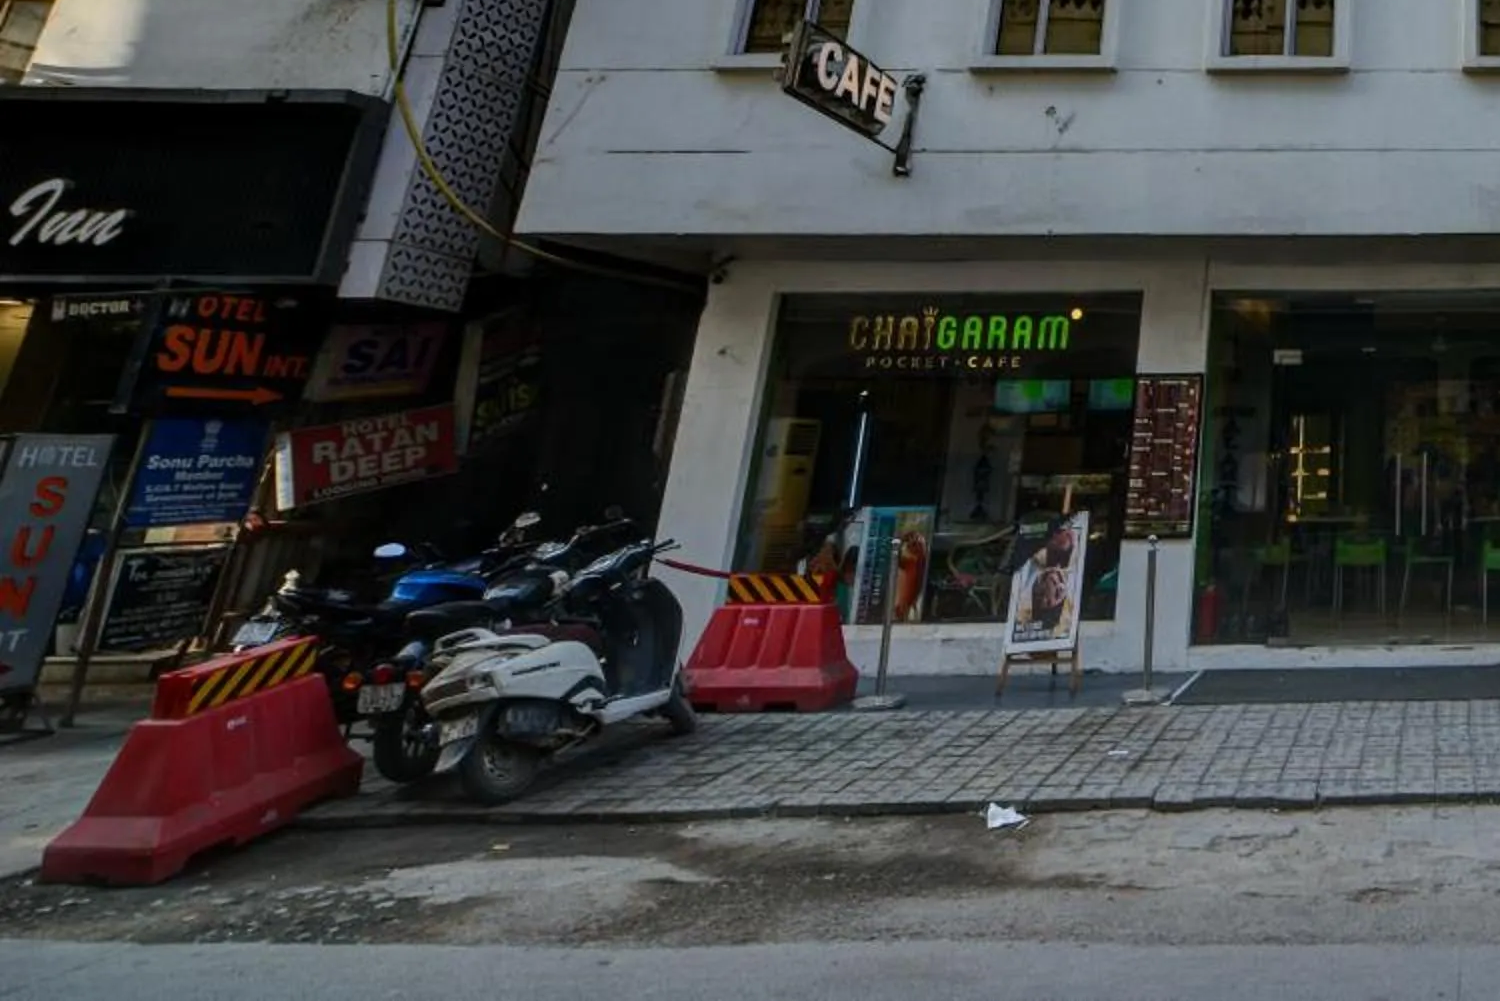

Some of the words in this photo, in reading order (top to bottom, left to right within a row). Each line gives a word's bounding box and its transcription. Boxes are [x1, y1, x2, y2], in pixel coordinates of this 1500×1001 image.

[817, 41, 897, 124] CAFE
[9, 178, 127, 246] Inn
[68, 299, 130, 317] DOCTOR
[166, 296, 268, 323] HOTEL
[156, 324, 265, 376] SUN
[343, 338, 433, 373] SAI
[865, 355, 948, 369] POCKET
[341, 411, 409, 437] HOTEL
[19, 446, 98, 469] HOTEL
[311, 420, 441, 464] RATAN
[146, 454, 194, 470] Sonu
[329, 445, 428, 483] DEEP
[0, 475, 69, 621] SUN
